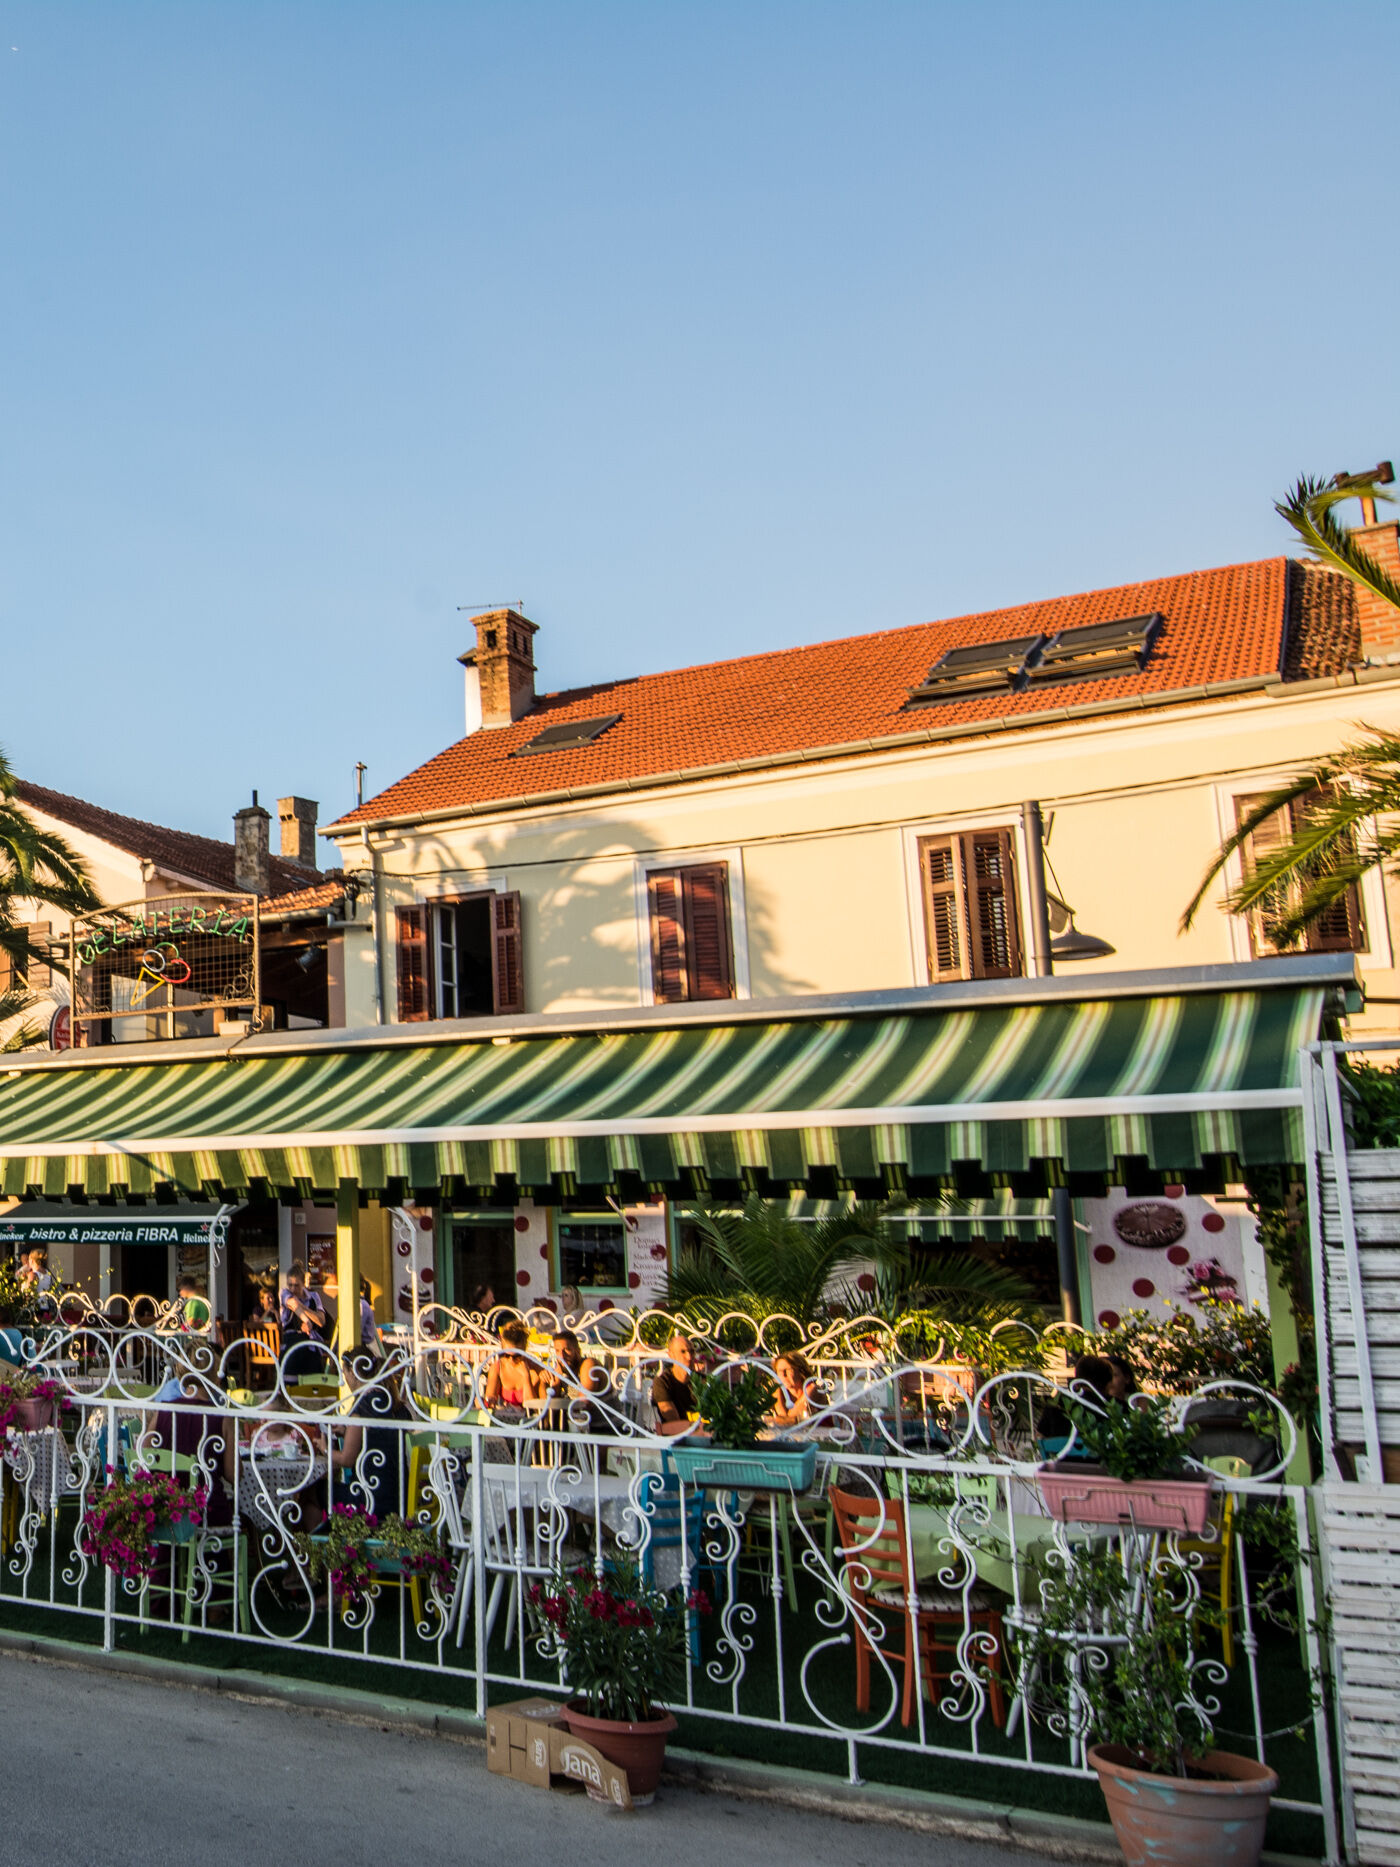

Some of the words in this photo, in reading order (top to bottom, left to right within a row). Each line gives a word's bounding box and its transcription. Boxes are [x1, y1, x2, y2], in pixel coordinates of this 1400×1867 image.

[76, 905, 249, 965] GELATERIA
[29, 1227, 66, 1240] bistro
[68, 1227, 79, 1241] &
[81, 1228, 133, 1243] pizzeria
[136, 1227, 179, 1242] FIBRA
[183, 1233, 225, 1243] Heineen
[563, 1752, 601, 1787] Jana
